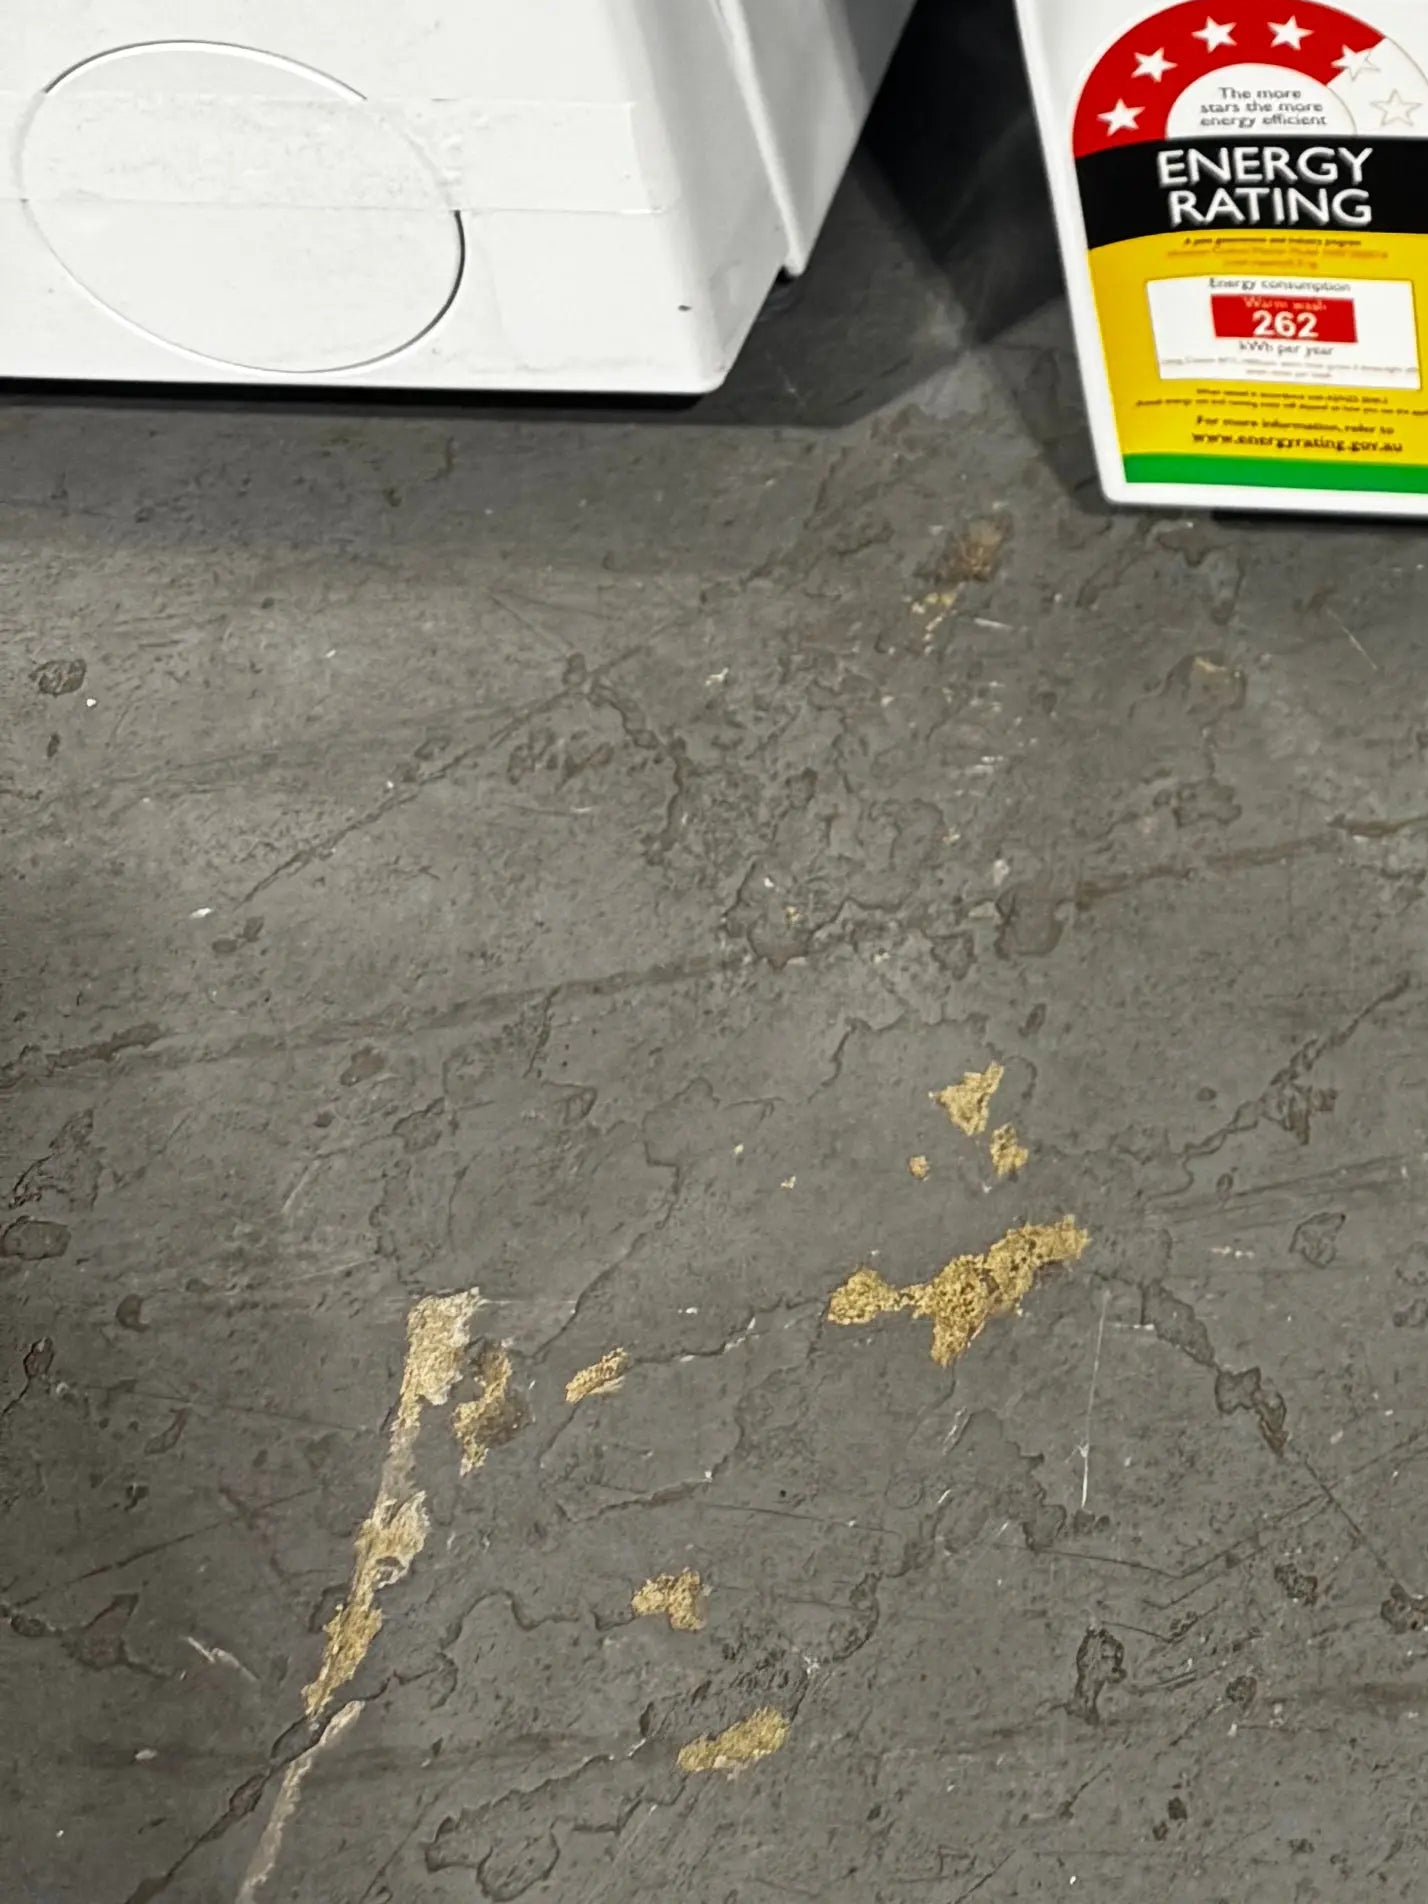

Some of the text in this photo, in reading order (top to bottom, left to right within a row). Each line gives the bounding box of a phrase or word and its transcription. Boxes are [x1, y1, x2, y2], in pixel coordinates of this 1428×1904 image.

[1219, 87, 1301, 99] The more
[1201, 101, 1323, 113] stars the more
[1200, 114, 1327, 128] energy efficient
[1157, 146, 1373, 188] ENERGY
[1168, 187, 1373, 227] RATING
[1209, 277, 1351, 292] Energy consumption
[1252, 310, 1319, 338] 262
